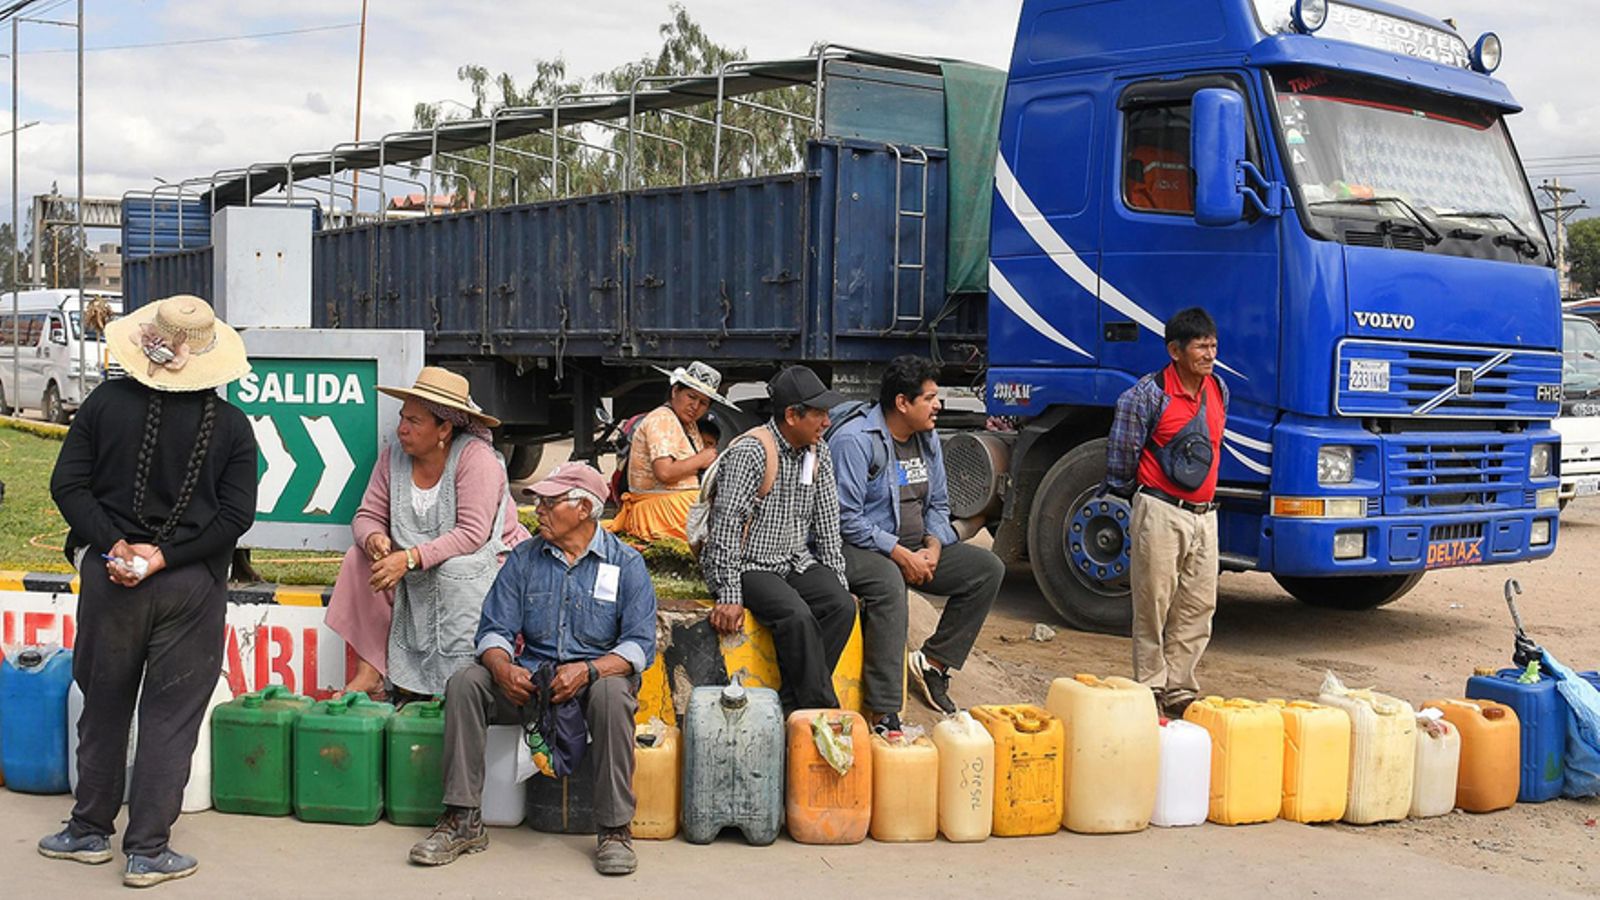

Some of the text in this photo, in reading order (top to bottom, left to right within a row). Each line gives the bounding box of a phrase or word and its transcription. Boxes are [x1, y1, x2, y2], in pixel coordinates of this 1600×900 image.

[1353, 311, 1415, 330] VOLVO
[237, 372, 365, 404] SALIDA
[1537, 385, 1560, 401] FH12
